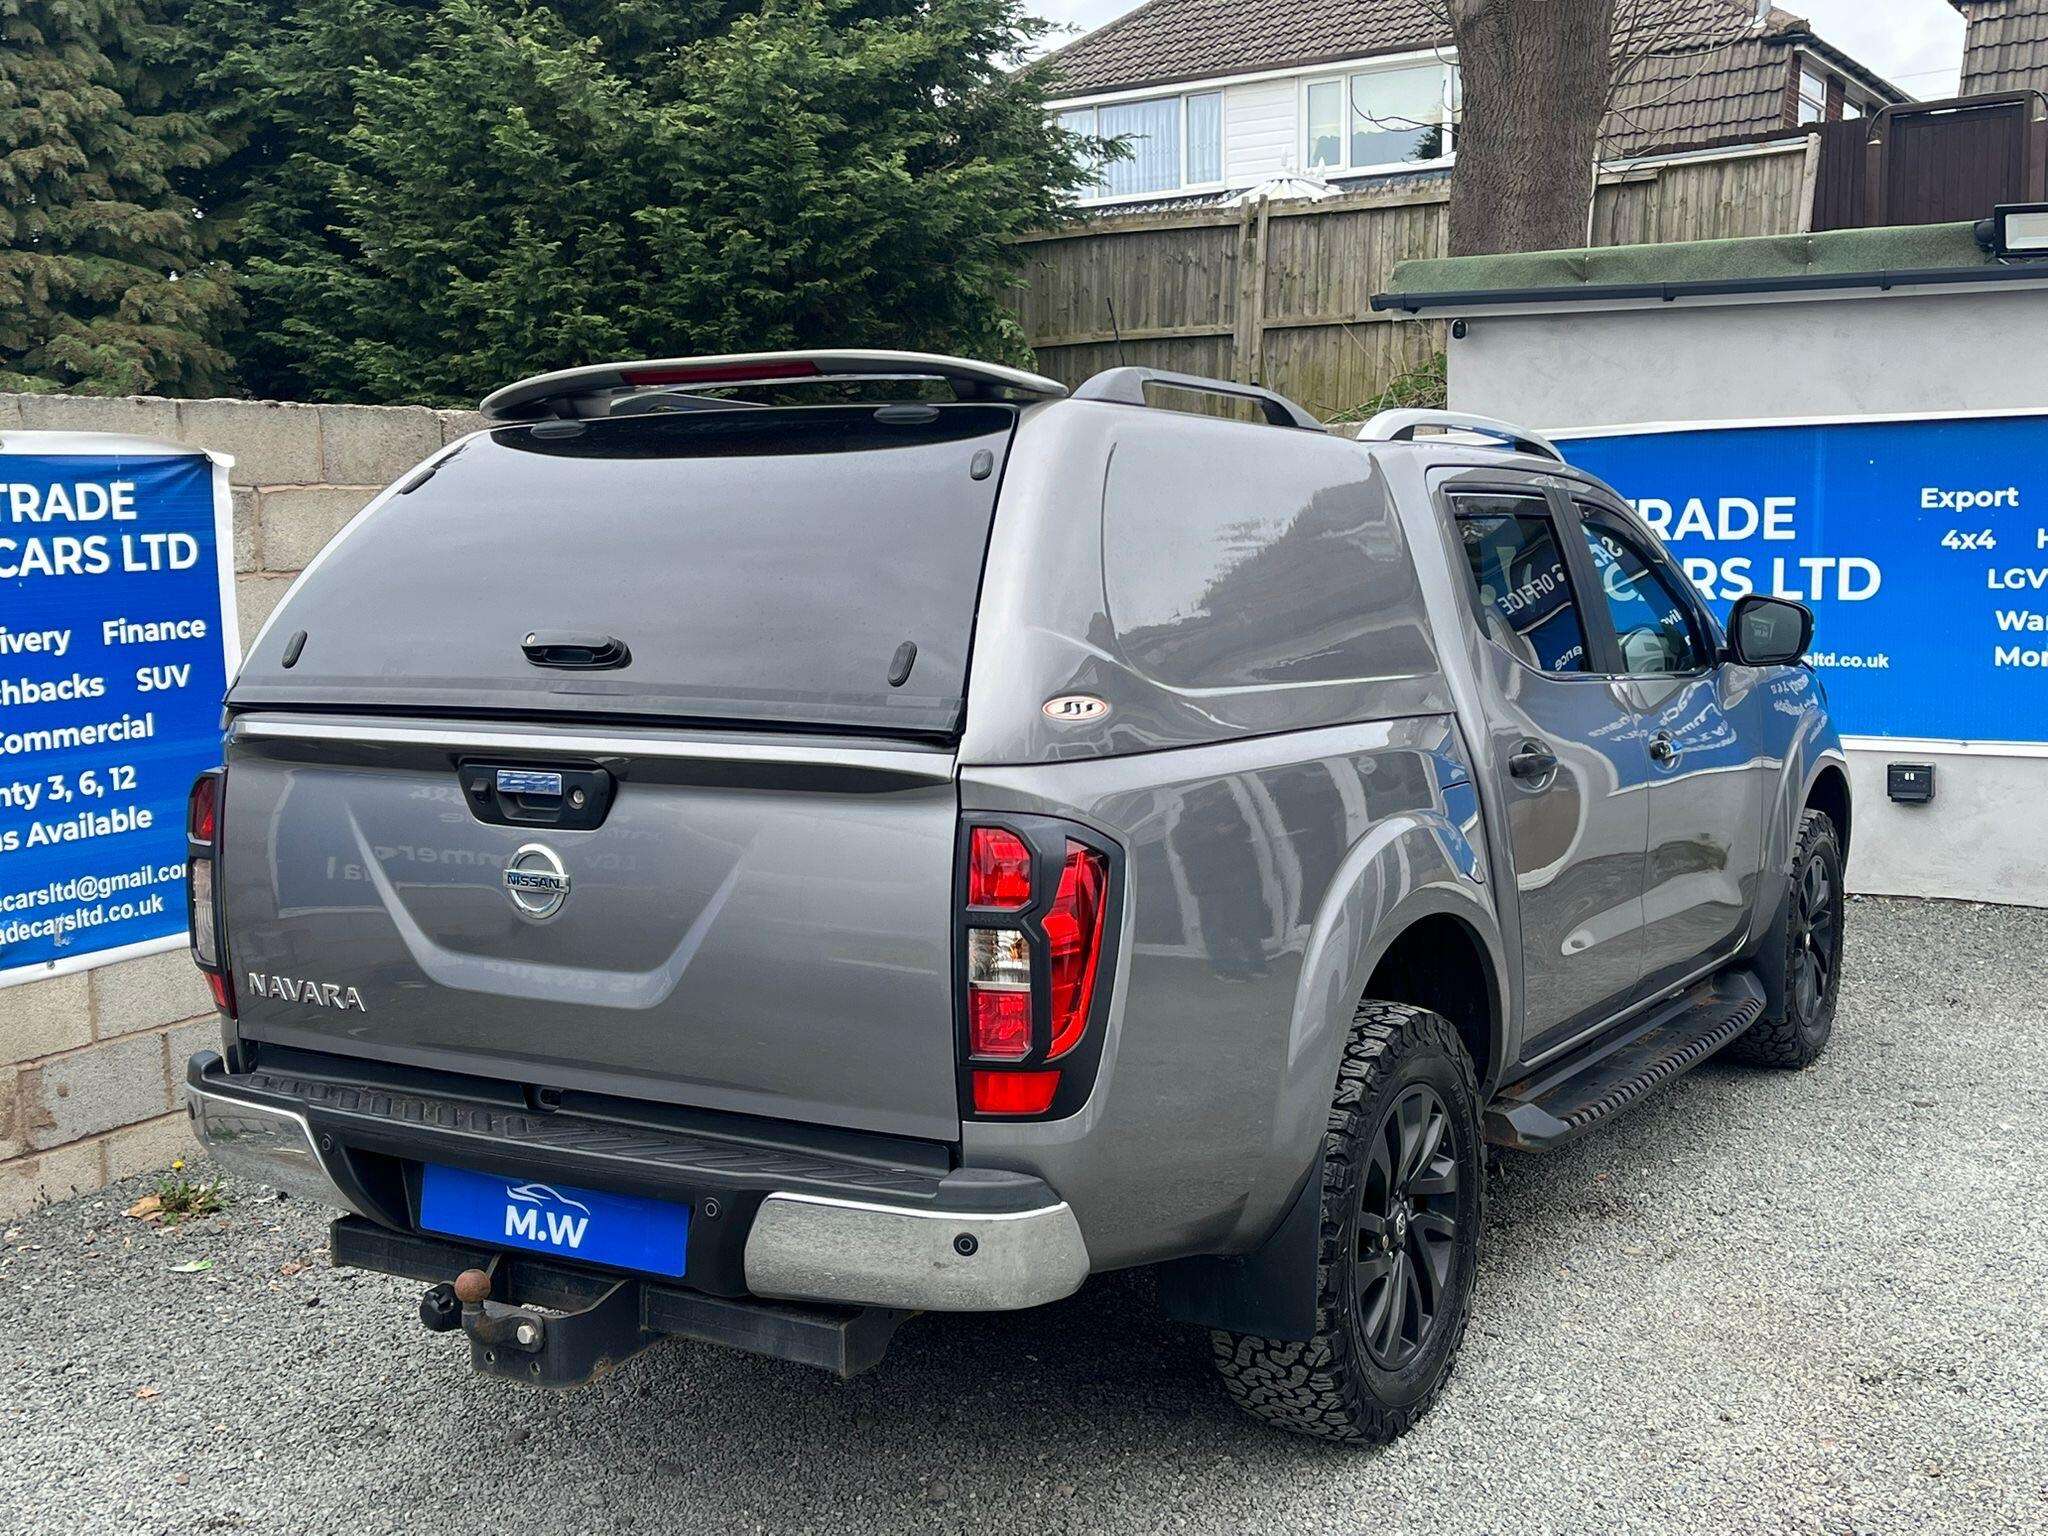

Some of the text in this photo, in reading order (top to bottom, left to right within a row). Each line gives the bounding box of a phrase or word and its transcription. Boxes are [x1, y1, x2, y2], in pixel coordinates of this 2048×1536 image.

[1626, 496, 1796, 541] RADE
[1920, 487, 2021, 513] Export
[121, 532, 199, 573] LTD
[1940, 528, 1997, 550] 4x4
[1771, 556, 1882, 601] LTD
[1987, 567, 2048, 590] LGV
[102, 617, 207, 646] Finance
[0, 663, 192, 706] hbacks SUV
[0, 712, 154, 755] ommercial
[47, 774, 73, 803] 3,
[78, 770, 104, 798] 6,
[108, 765, 137, 792] 12
[26, 804, 153, 849] Available
[0, 862, 187, 914] carsltd@gmail.co
[507, 874, 561, 891] NISSAN
[248, 972, 367, 1012] NAVARA
[504, 1204, 589, 1249] M.W
